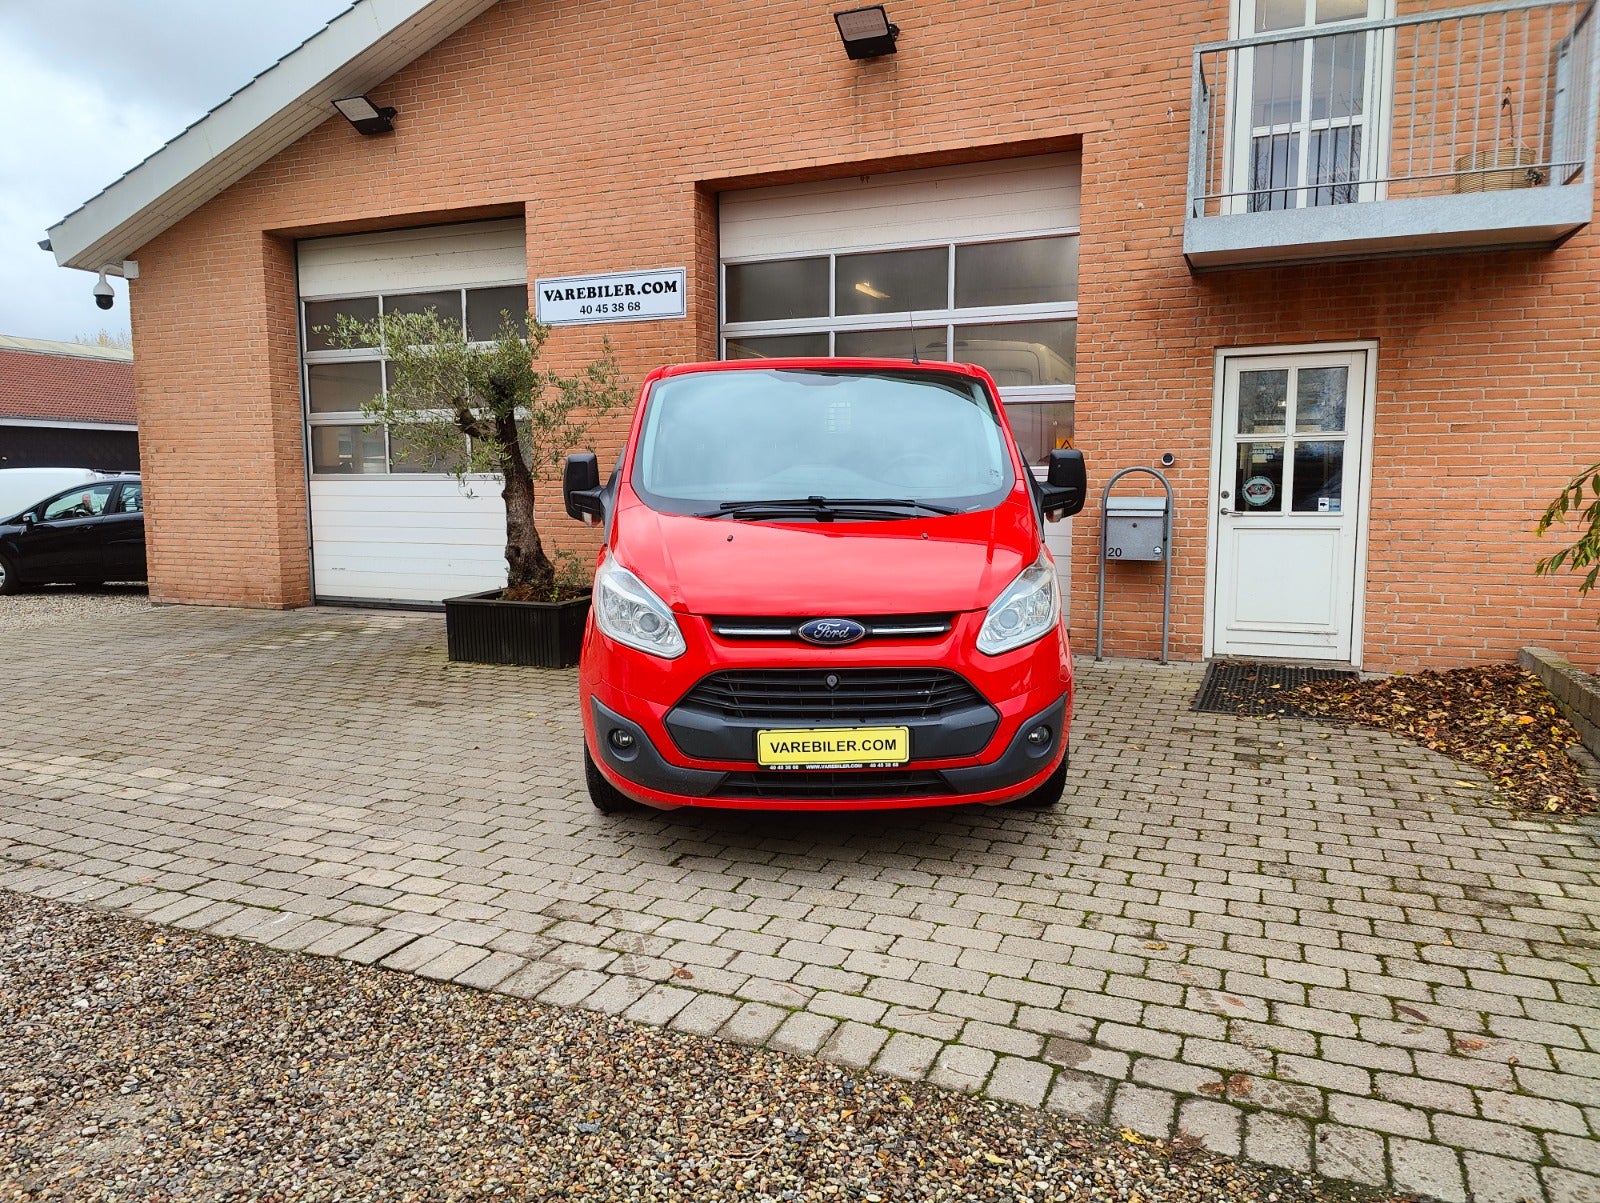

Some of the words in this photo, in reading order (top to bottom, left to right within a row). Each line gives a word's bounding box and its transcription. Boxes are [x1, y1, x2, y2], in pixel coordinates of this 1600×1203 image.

[543, 280, 678, 302] VAREBILER.COM
[579, 304, 593, 315] 40
[595, 303, 609, 314] 45
[611, 302, 625, 313] 38
[627, 301, 641, 312] 68
[1107, 547, 1122, 558] 20
[813, 622, 850, 638] Ford
[769, 739, 897, 754] VAREBILER.COM
